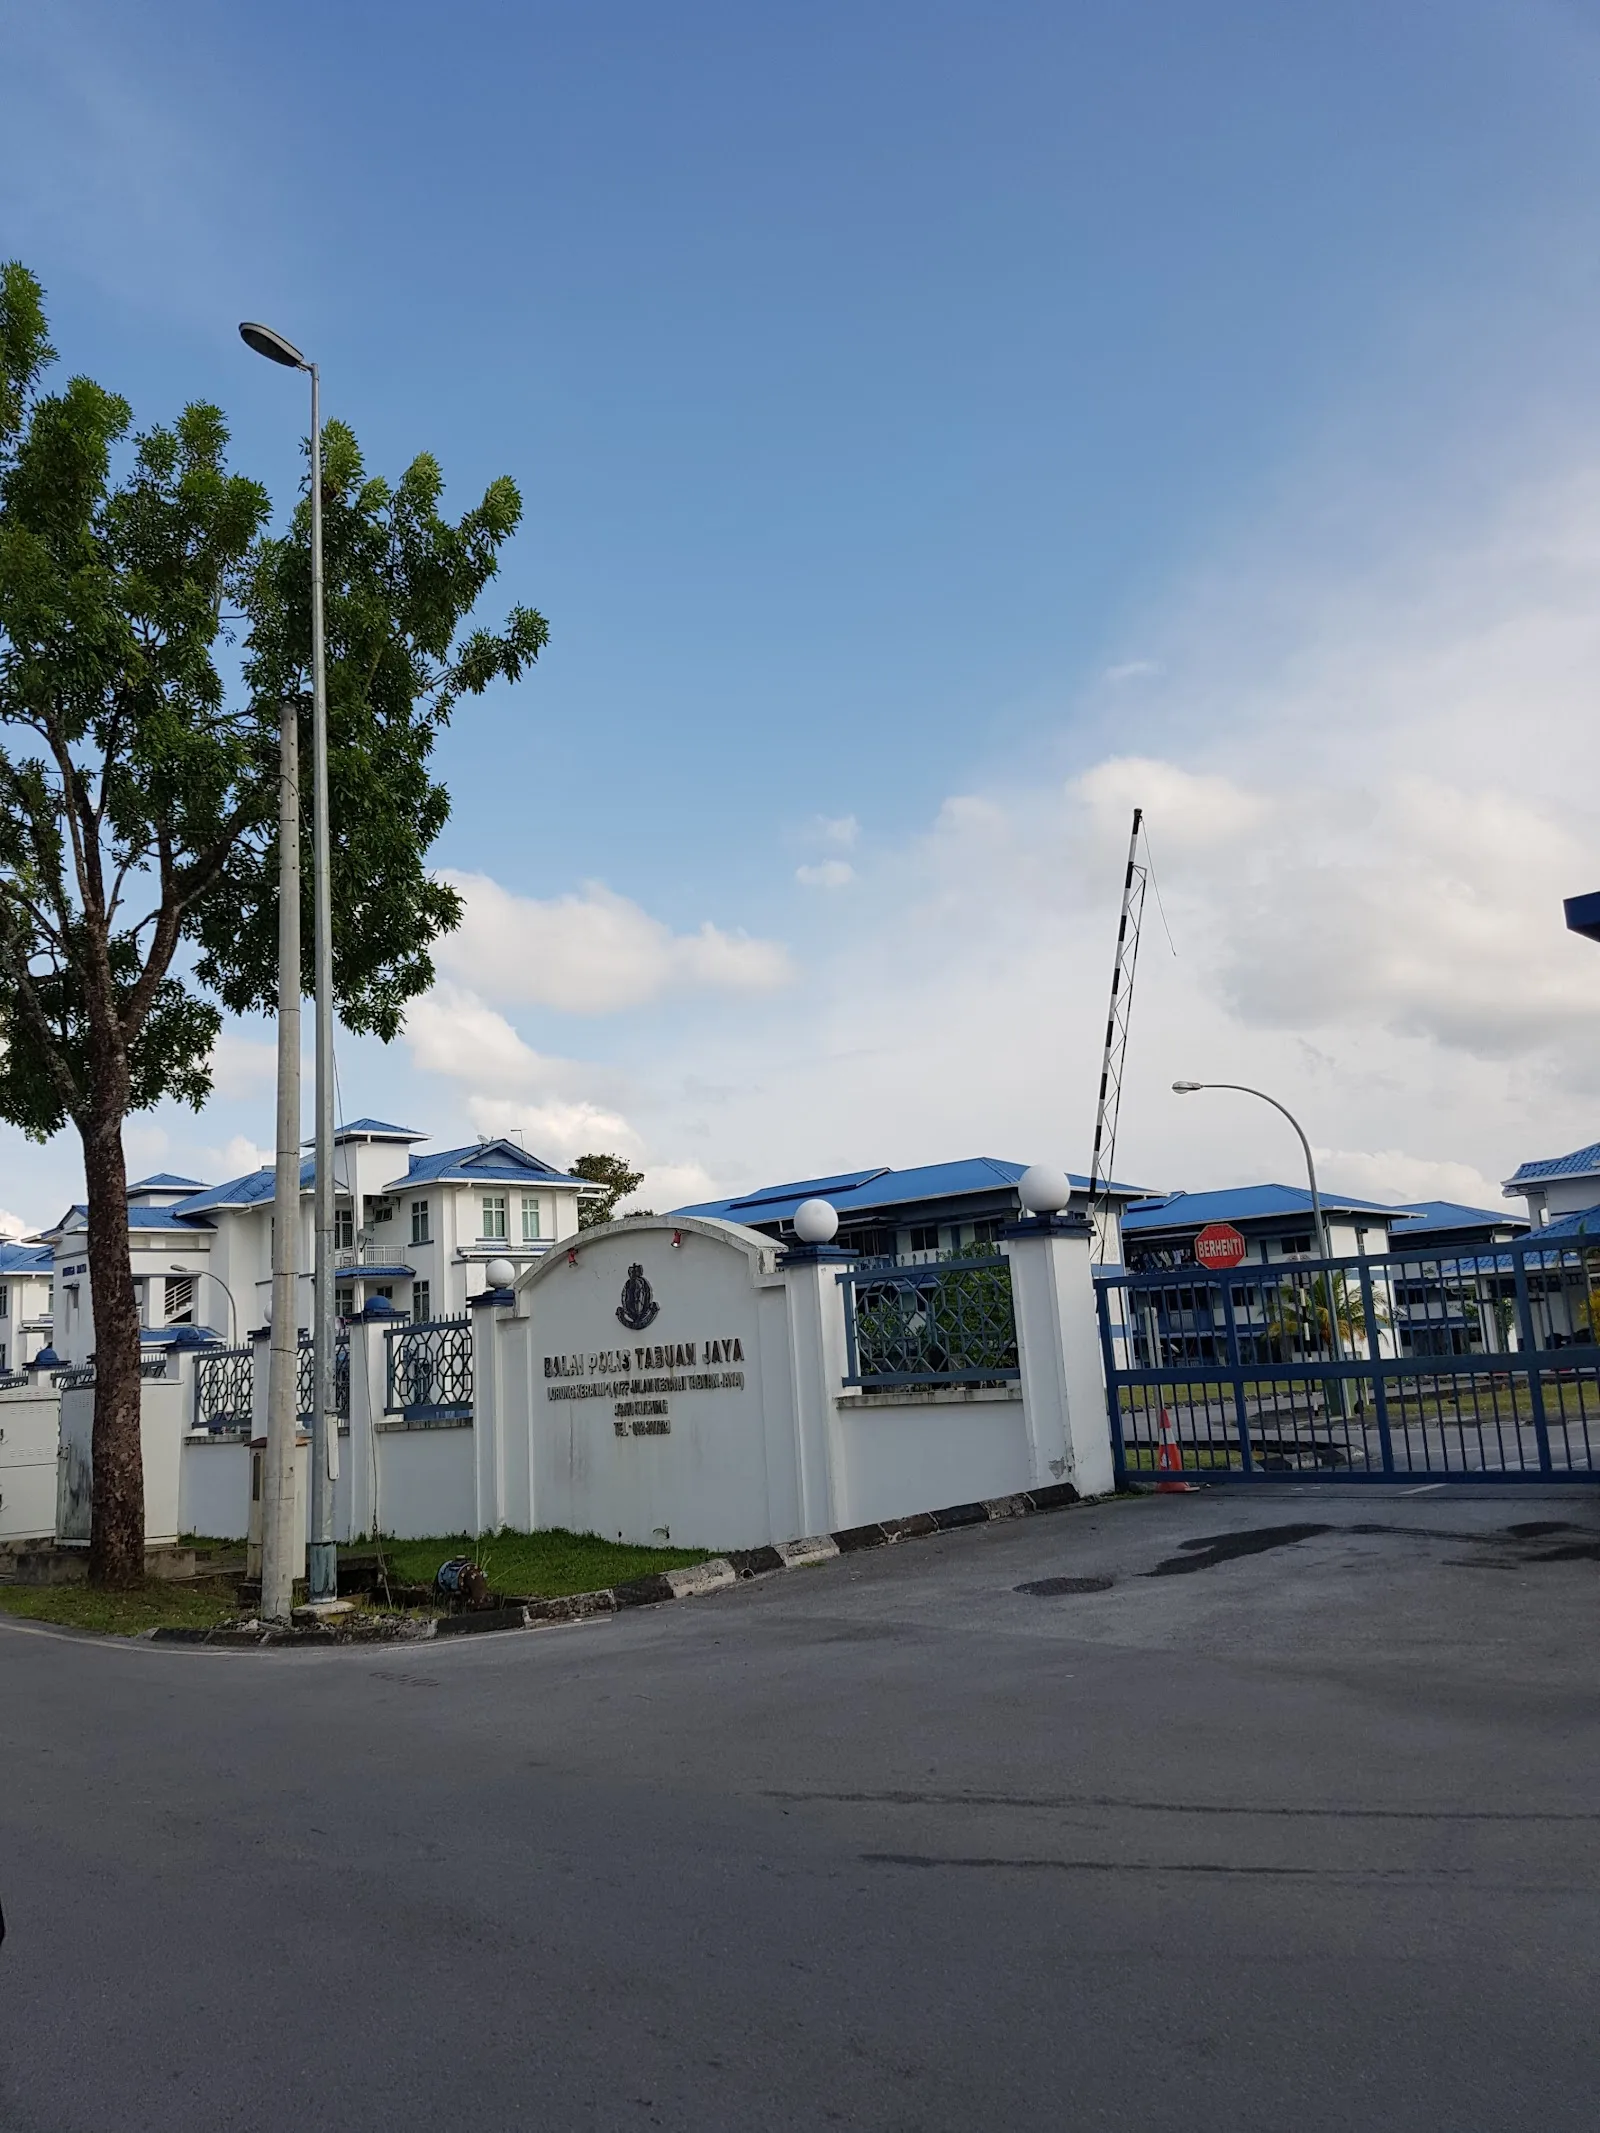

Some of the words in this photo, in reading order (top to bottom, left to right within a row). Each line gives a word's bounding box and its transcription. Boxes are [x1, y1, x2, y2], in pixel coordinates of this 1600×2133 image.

[1198, 1238, 1243, 1258] BERHENTI
[544, 1354, 584, 1378] BALAI
[588, 1349, 631, 1375] POLIS
[634, 1342, 697, 1370] TABUAN
[702, 1338, 745, 1365] JAYA
